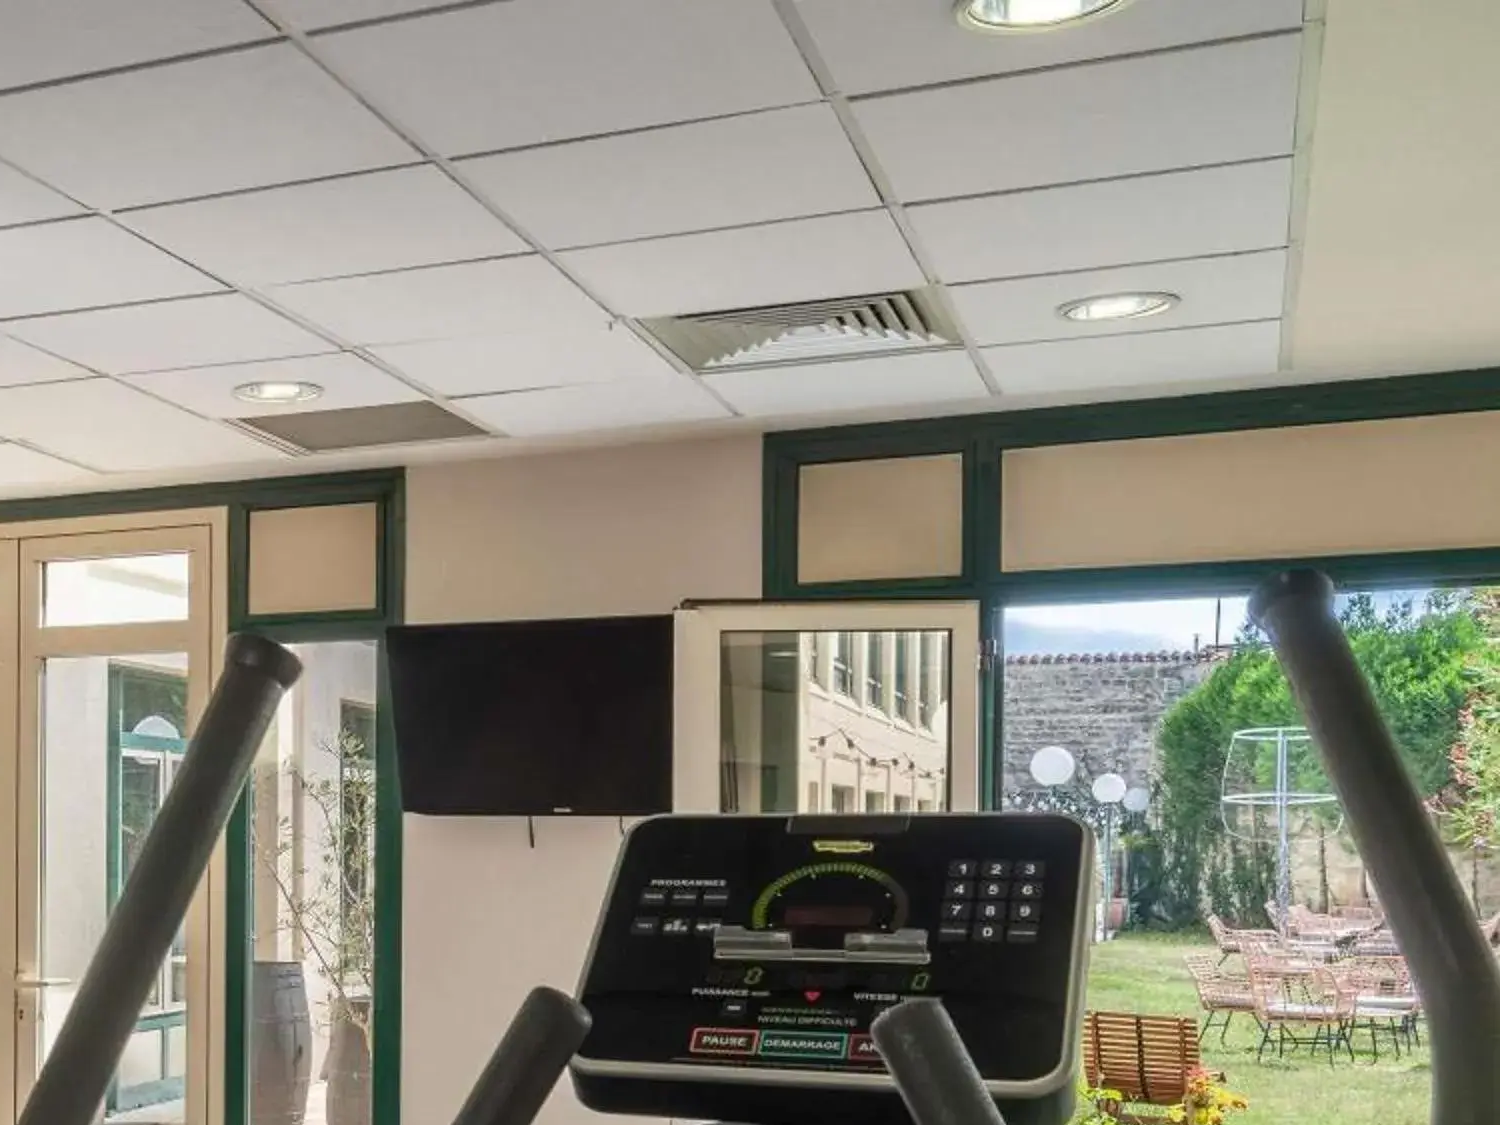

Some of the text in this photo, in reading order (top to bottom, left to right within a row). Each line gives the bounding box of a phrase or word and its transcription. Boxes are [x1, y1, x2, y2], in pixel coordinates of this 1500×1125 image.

[990, 864, 1001, 875] 2
[1025, 864, 1035, 874] 3
[954, 884, 1033, 895] 4 5 6
[951, 904, 962, 916] 7
[1020, 905, 1031, 917] 9
[982, 927, 993, 937] 0
[702, 1035, 748, 1047] PAUSE
